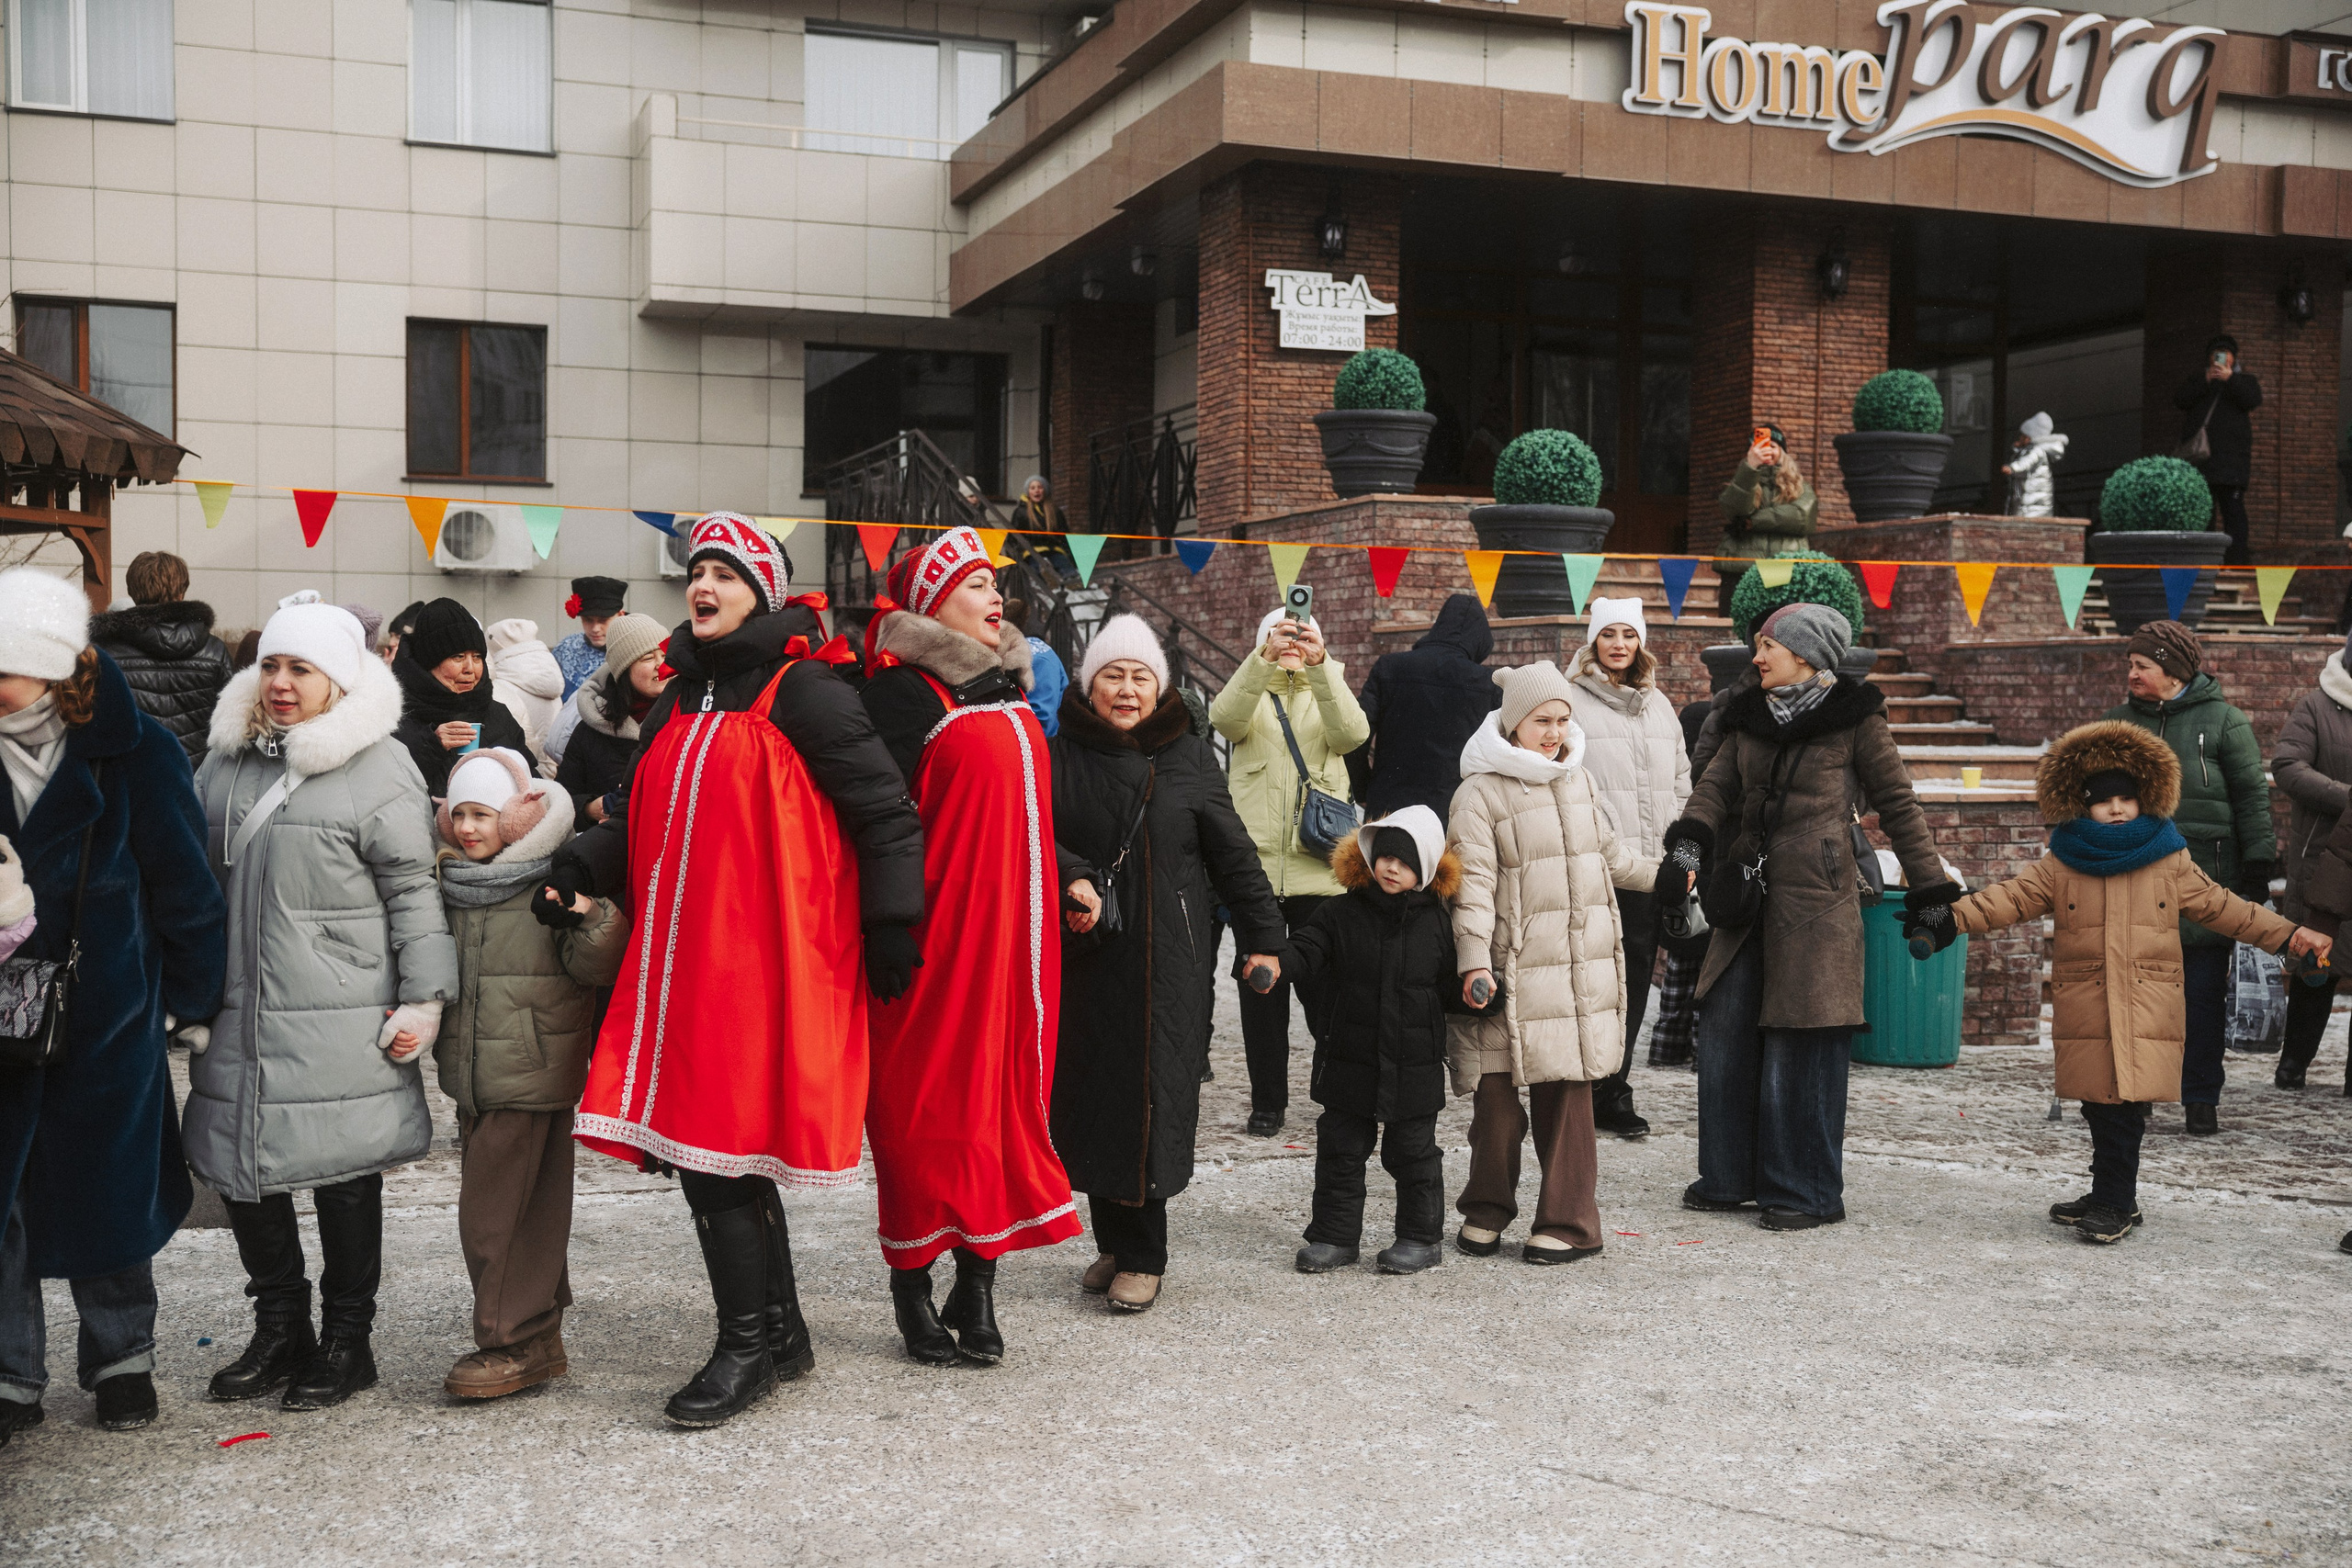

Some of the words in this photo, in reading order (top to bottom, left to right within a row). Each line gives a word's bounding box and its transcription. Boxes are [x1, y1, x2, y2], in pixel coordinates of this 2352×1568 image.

[1294, 275, 1329, 286] CAFE
[1288, 321, 1318, 333] Время
[1283, 333, 1318, 345] 07:00
[1329, 335, 1363, 348] 24:00
